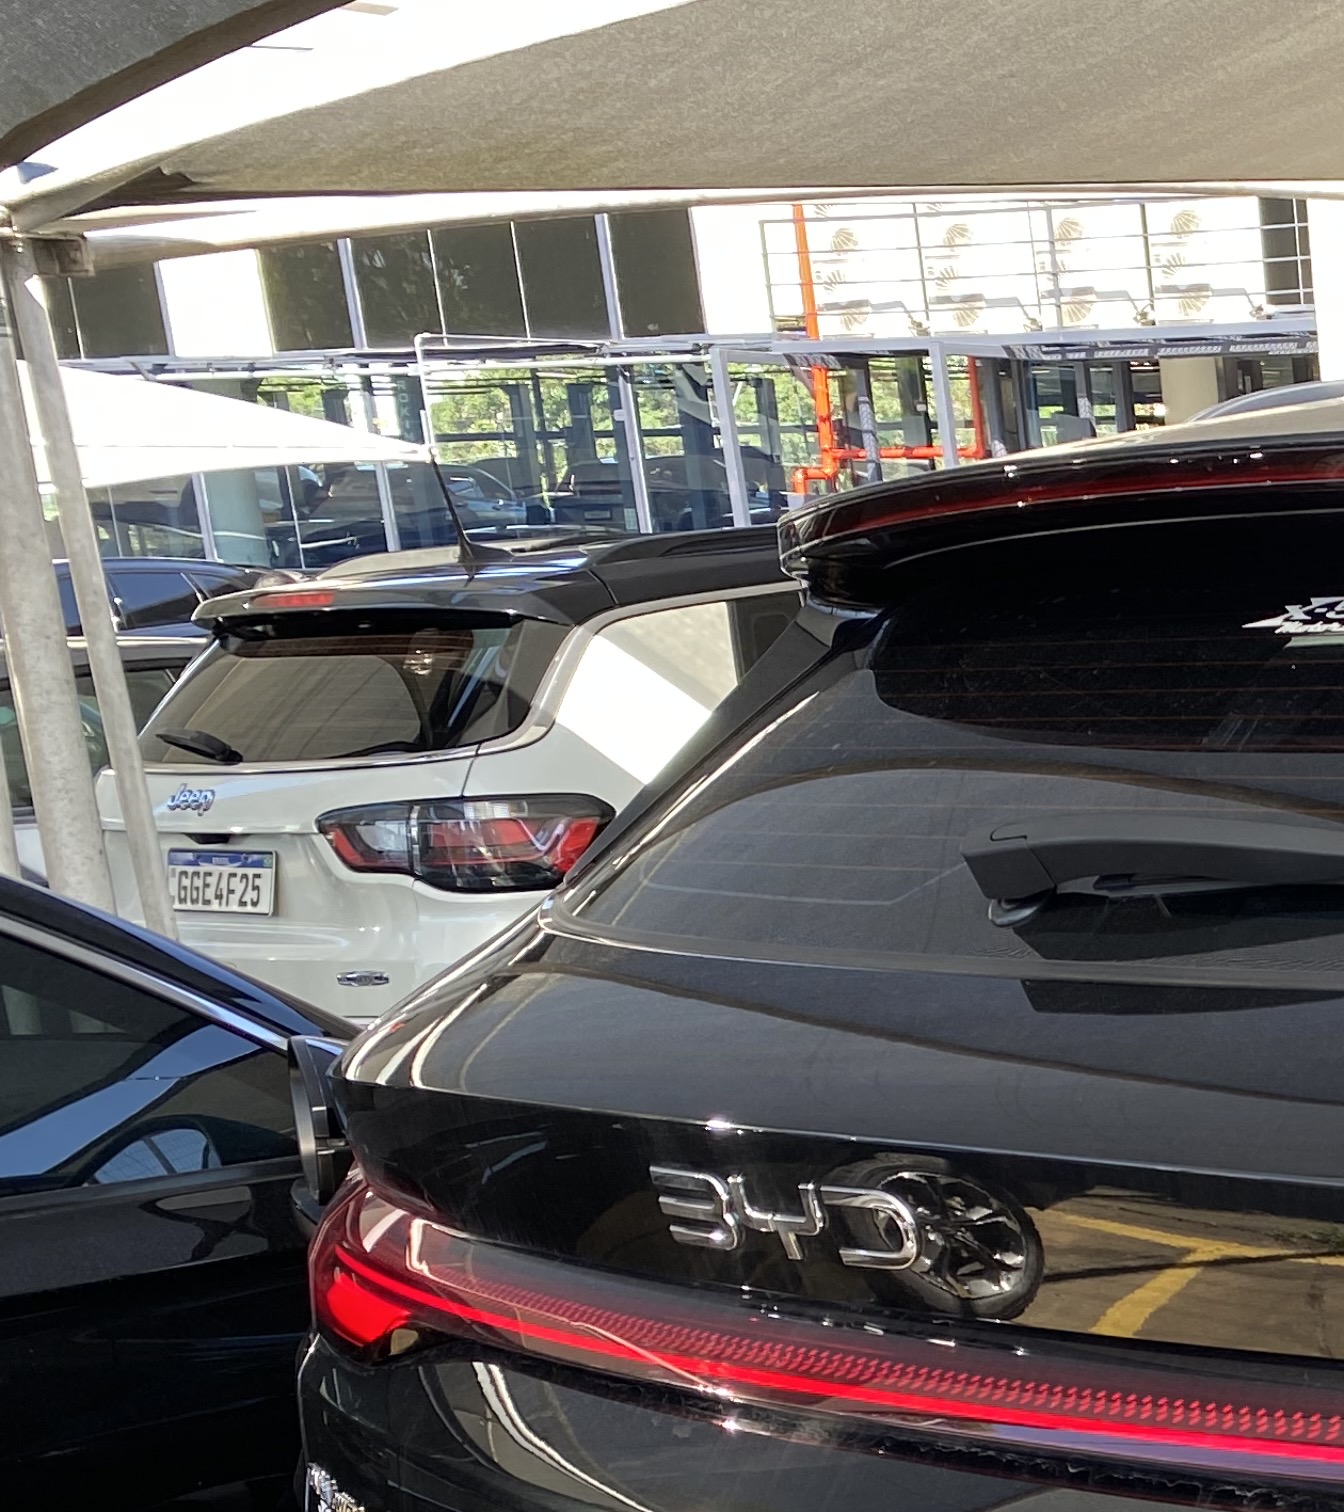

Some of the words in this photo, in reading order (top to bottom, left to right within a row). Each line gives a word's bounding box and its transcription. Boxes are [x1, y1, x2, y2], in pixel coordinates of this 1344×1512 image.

[167, 783, 215, 816] Jeep
[177, 870, 262, 908] GGE4F25
[650, 1165, 919, 1269] BYD
